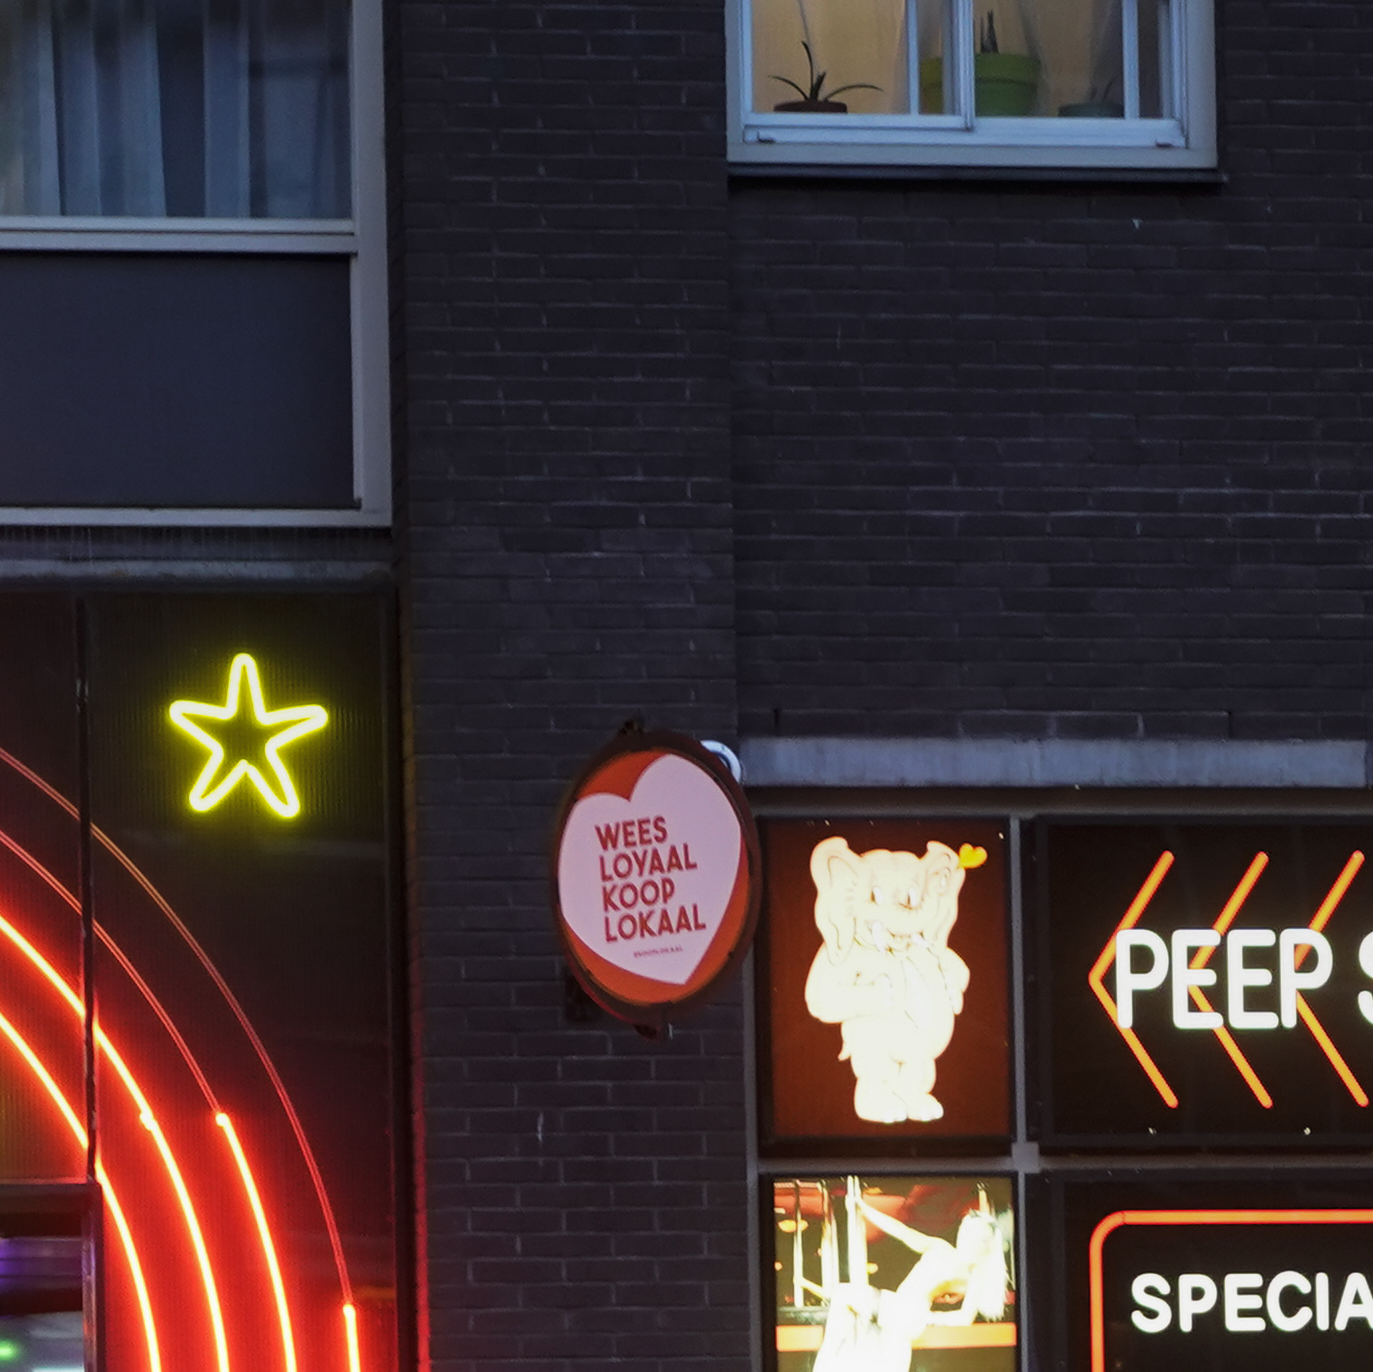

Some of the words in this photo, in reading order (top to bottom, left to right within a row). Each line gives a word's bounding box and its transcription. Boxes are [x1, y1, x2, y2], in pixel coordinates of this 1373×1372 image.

[595, 816, 668, 851] WEES
[599, 843, 697, 882] LOYAAL
[602, 877, 675, 912] KOOP
[604, 904, 707, 943] LOKAAL
[1114, 928, 1334, 1030] PEEP
